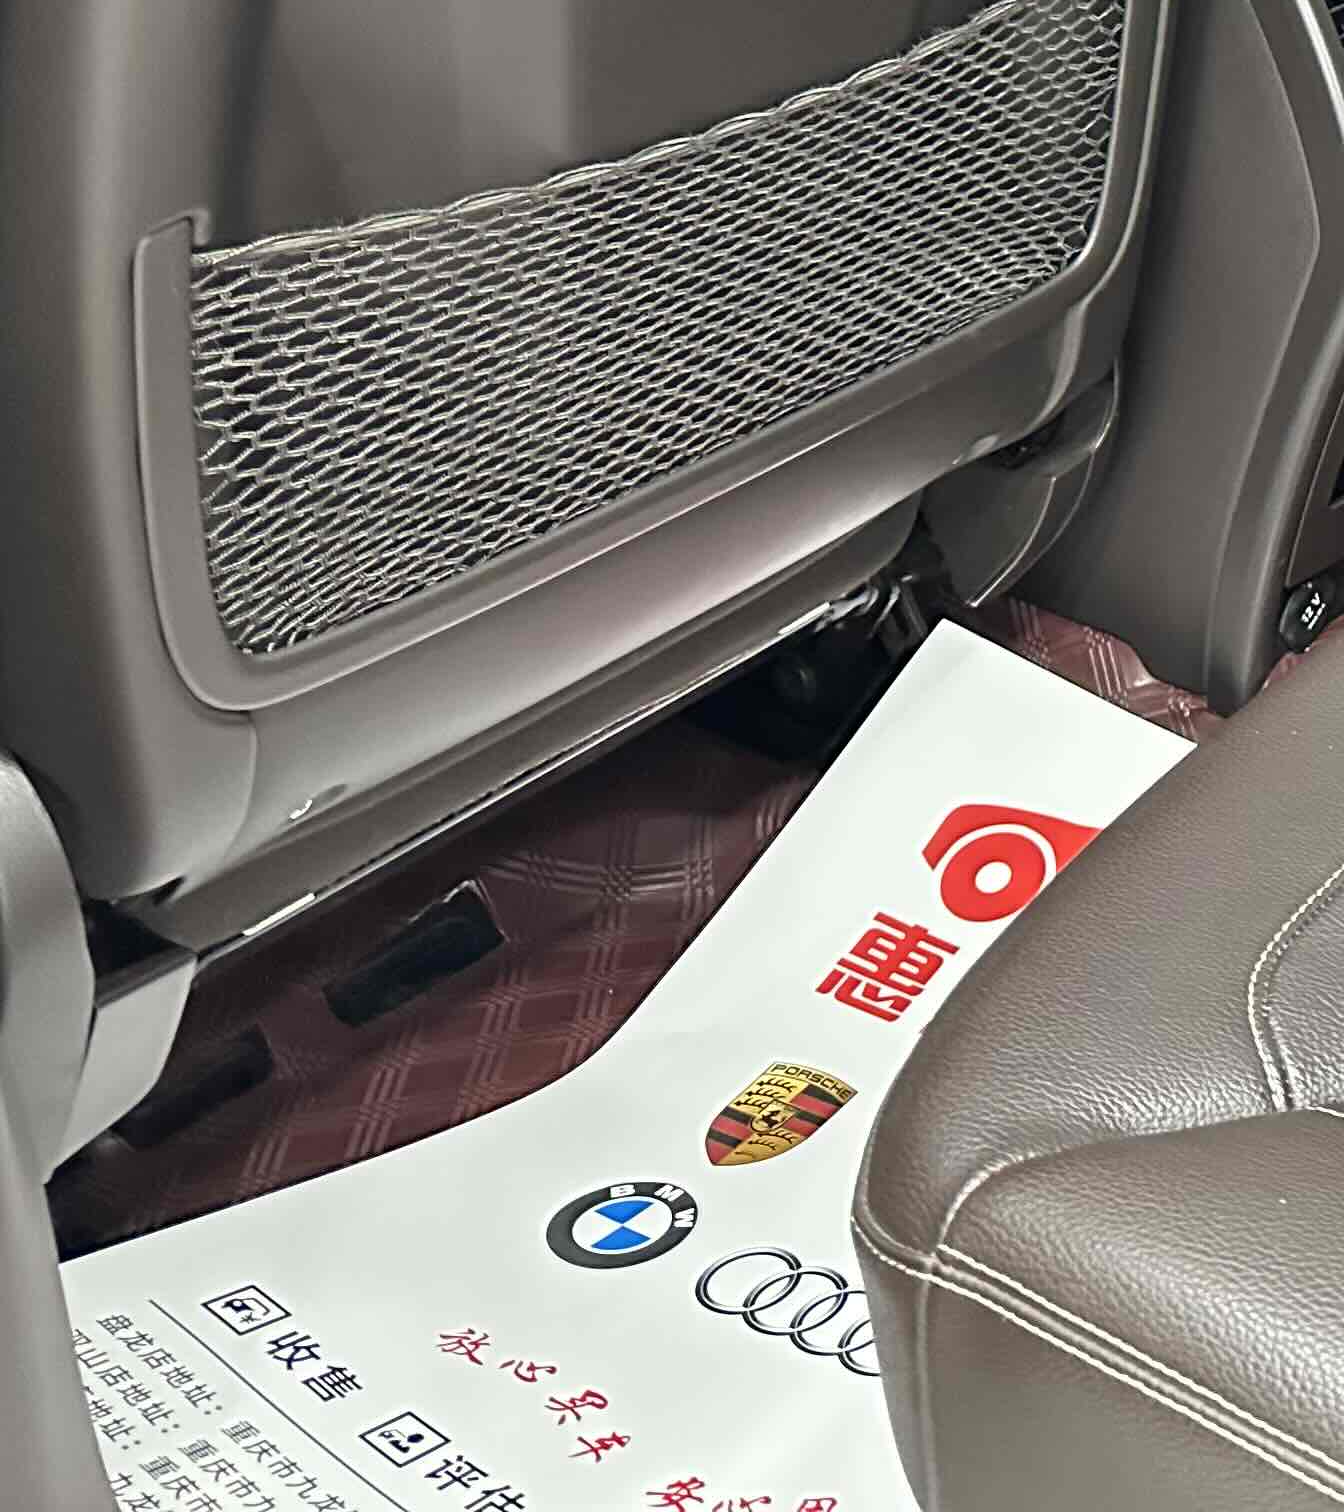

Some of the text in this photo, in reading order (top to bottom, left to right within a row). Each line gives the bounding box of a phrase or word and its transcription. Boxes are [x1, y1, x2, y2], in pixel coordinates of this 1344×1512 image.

[771, 1064, 853, 1101] PORSCHE
[610, 1184, 695, 1228] BMW
[267, 1331, 363, 1402] 收售
